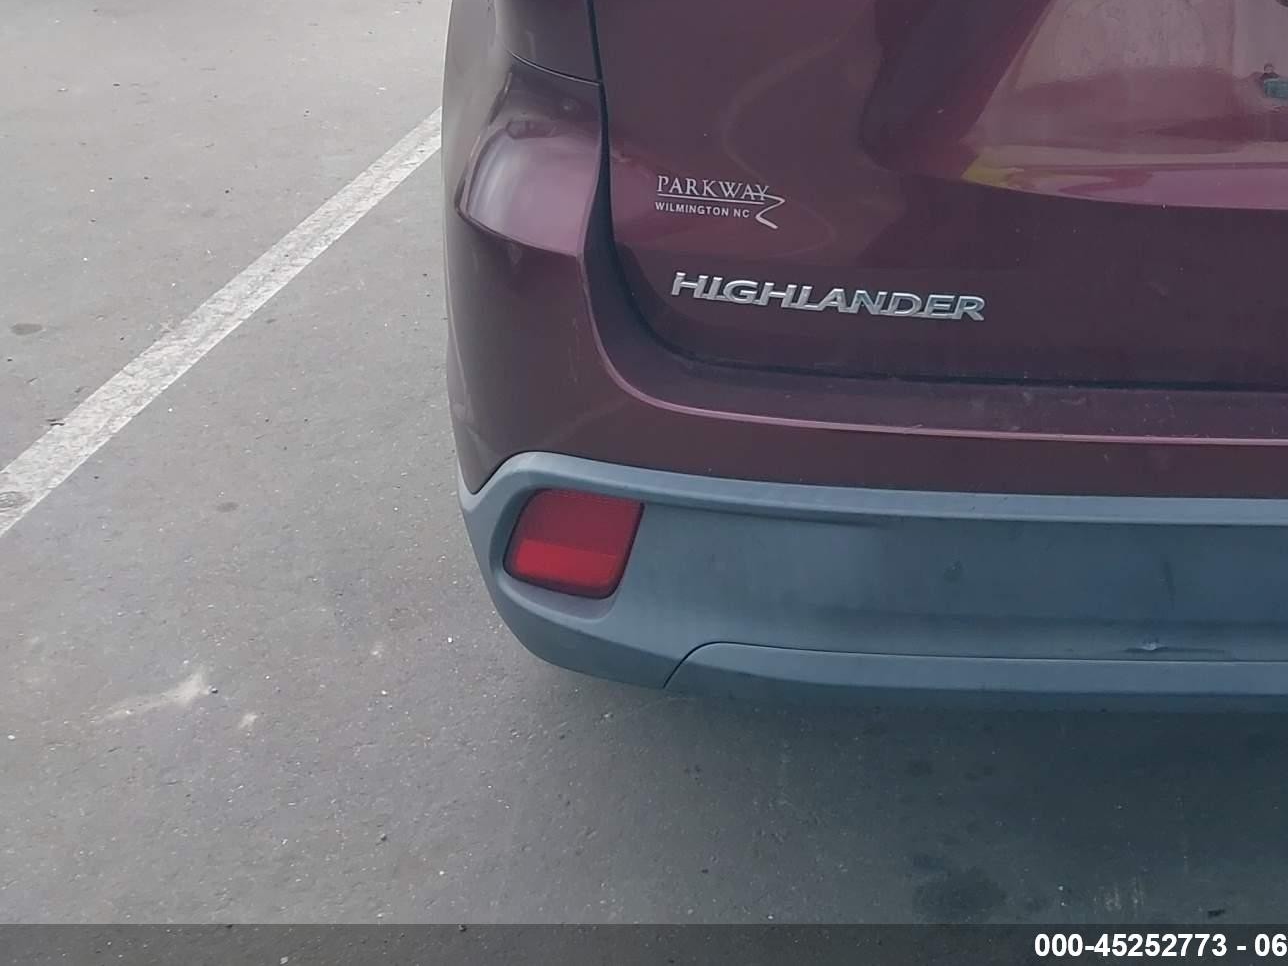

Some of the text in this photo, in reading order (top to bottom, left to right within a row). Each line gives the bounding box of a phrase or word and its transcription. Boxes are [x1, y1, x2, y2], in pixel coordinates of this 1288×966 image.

[656, 174, 769, 203] PARKWAY
[655, 201, 750, 219] WILMINGTON NC
[671, 271, 986, 322] HIGHLANDER
